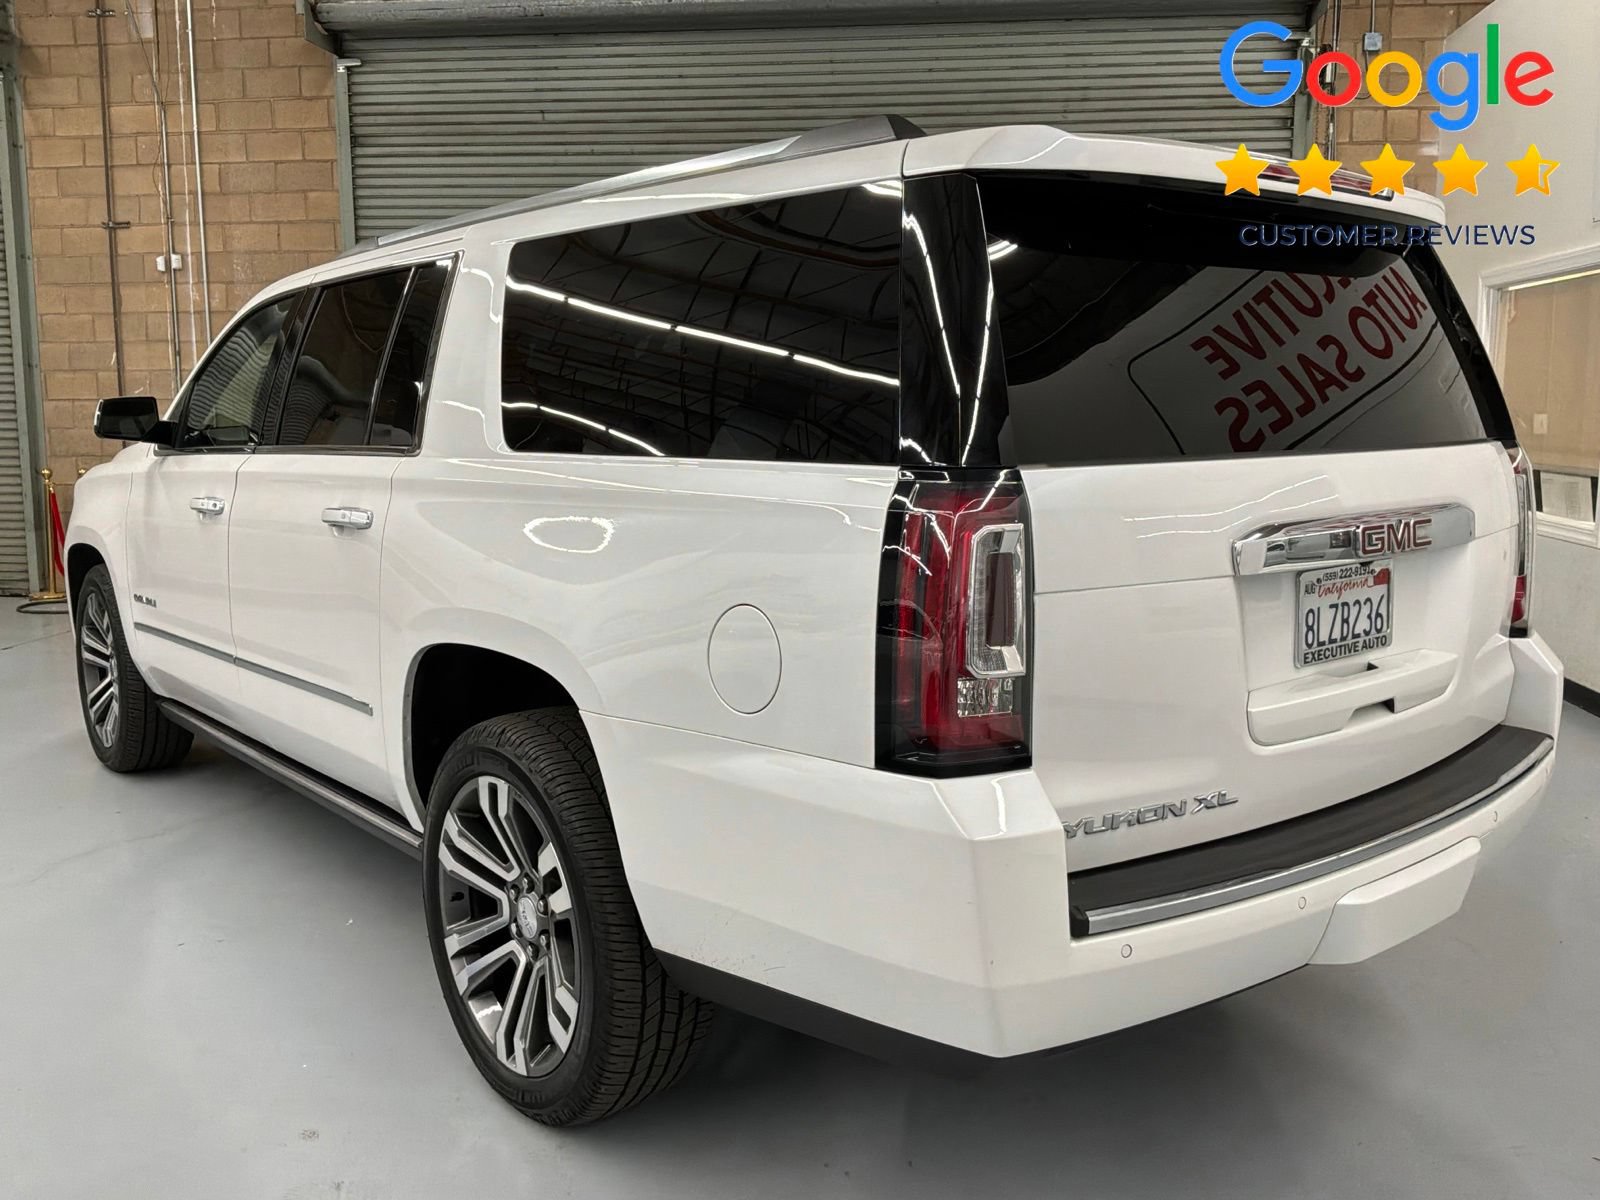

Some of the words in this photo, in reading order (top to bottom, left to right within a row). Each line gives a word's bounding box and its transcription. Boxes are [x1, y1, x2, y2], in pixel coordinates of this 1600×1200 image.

[1360, 518, 1432, 556] GMC
[1317, 577, 1370, 600] California
[1304, 594, 1385, 649] 8LZB236
[1303, 640, 1360, 665] EXECUTIVE
[1360, 634, 1387, 651] AUTO
[1062, 799, 1187, 839] YUKON
[1190, 789, 1239, 815] XL
